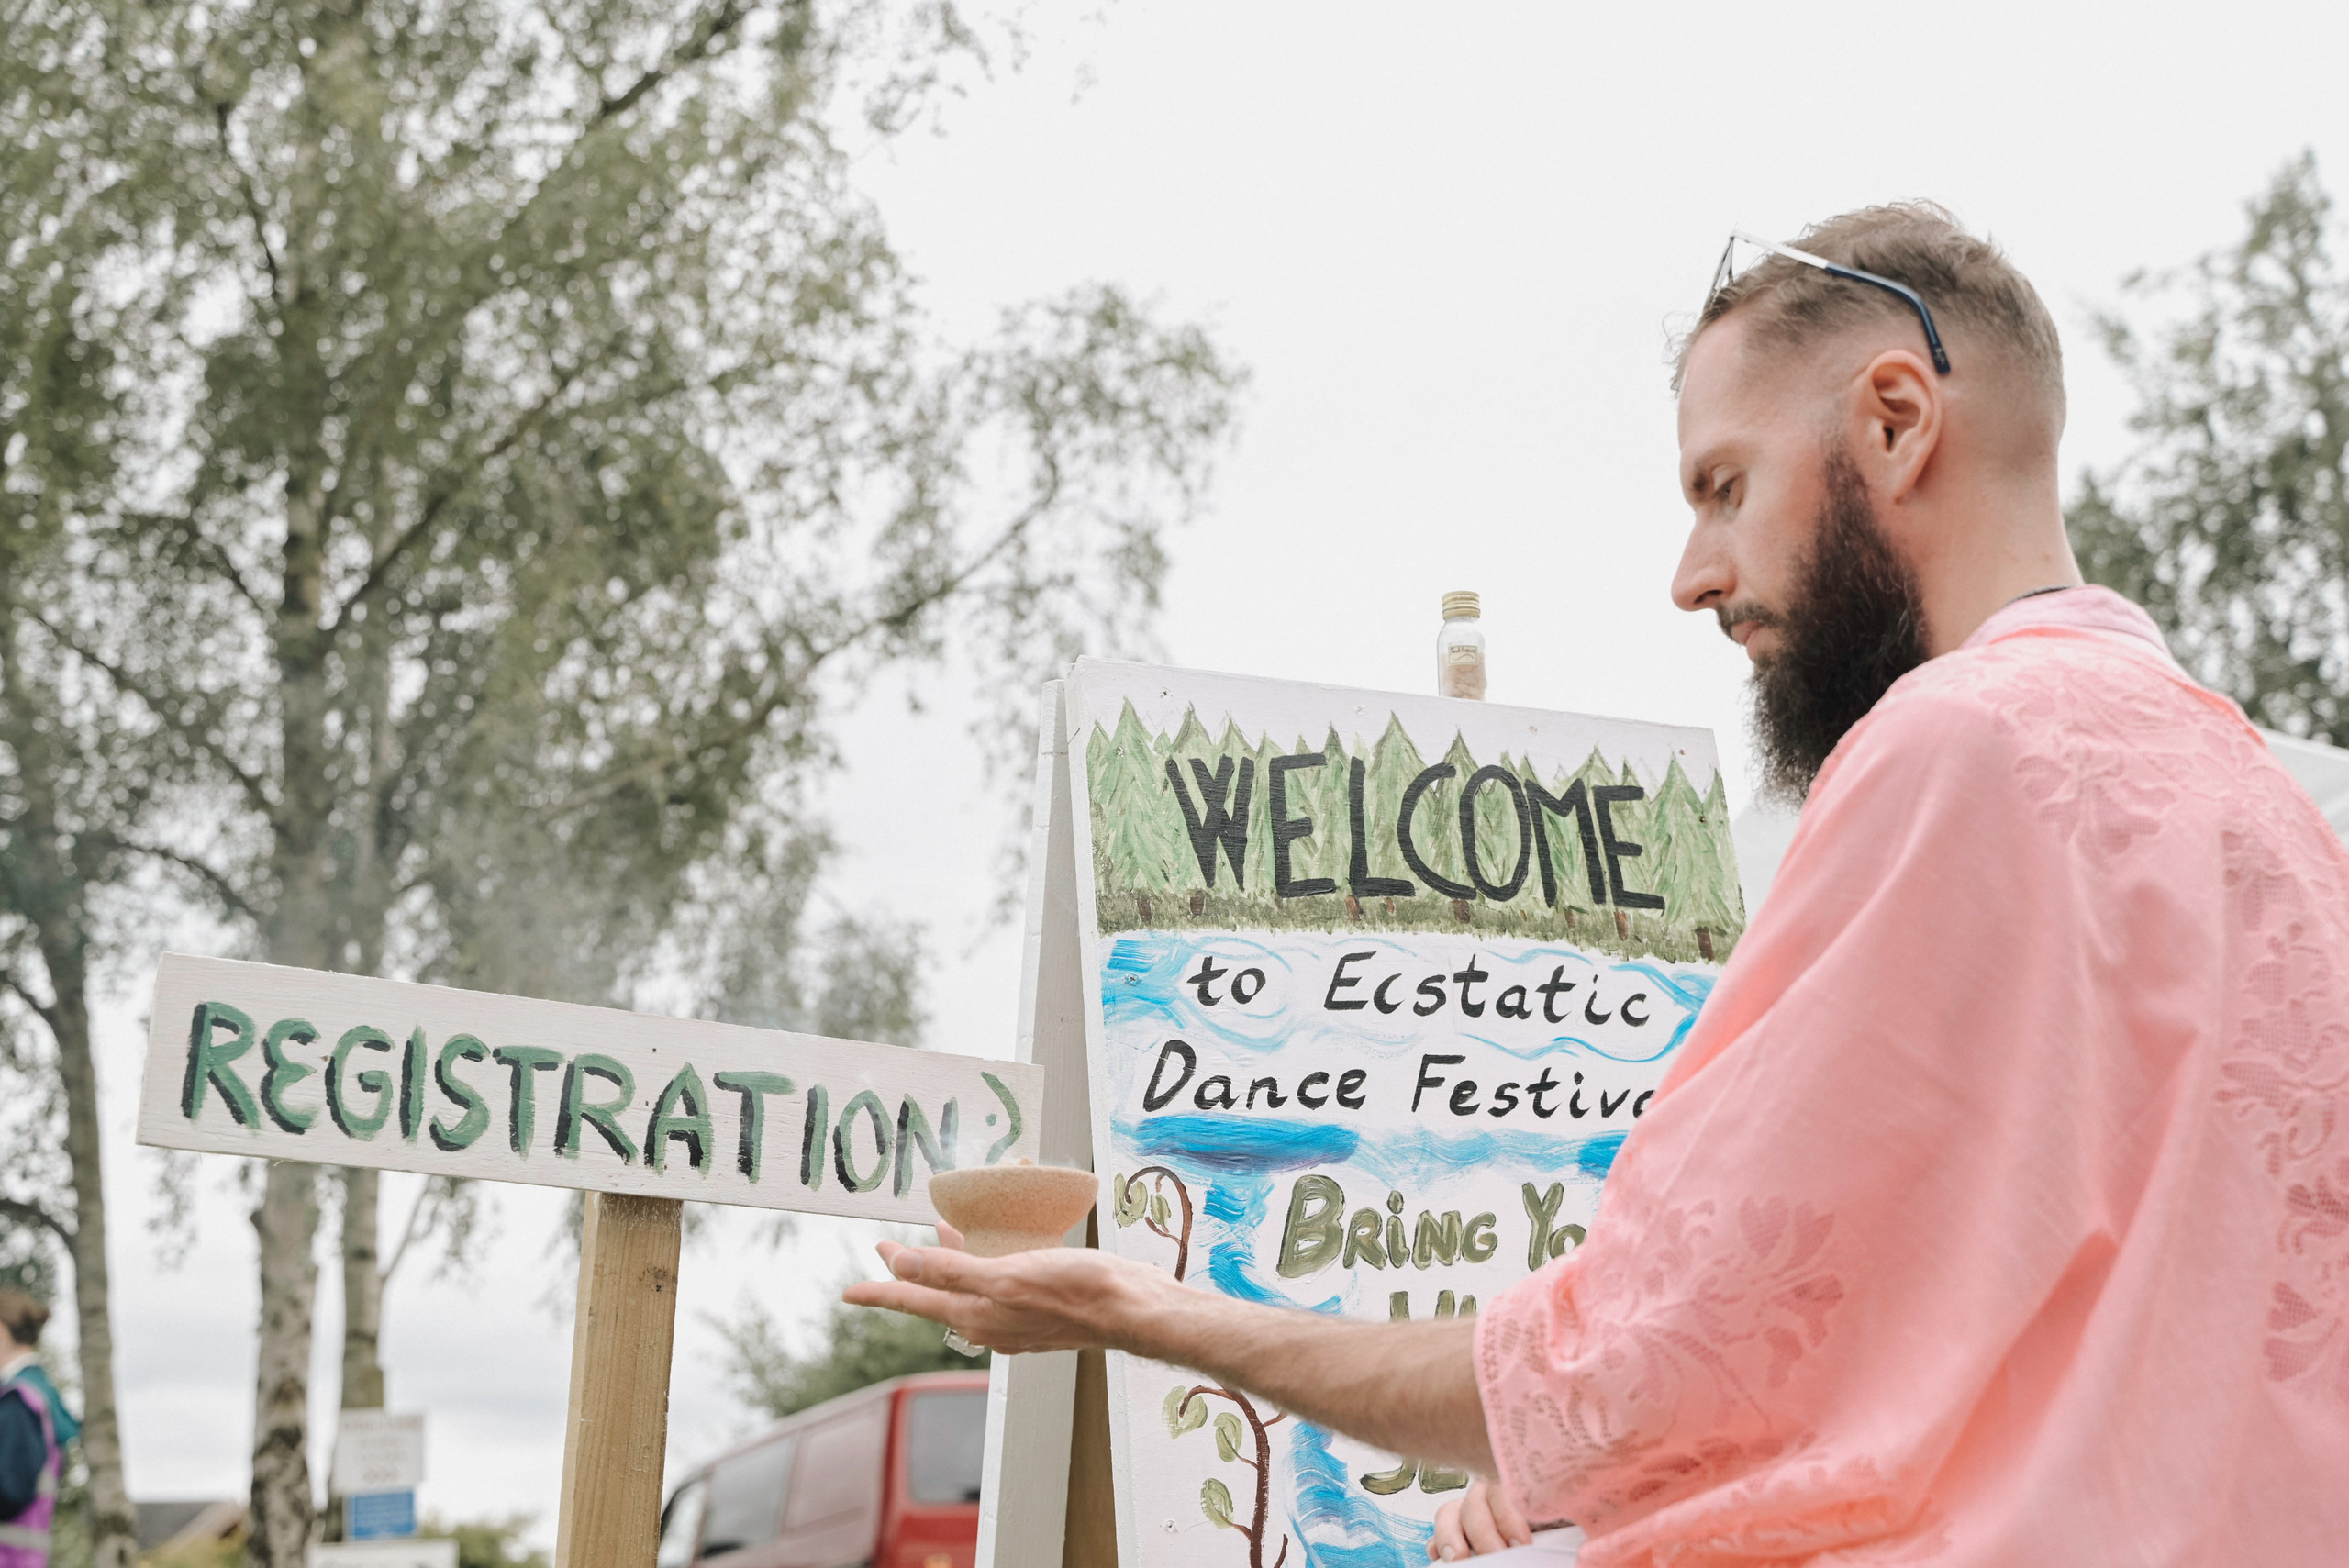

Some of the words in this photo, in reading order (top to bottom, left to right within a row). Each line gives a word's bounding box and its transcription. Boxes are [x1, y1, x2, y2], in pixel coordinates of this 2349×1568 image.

[1165, 754, 1665, 912] WELCOME
[1186, 955, 1266, 1006] to
[1323, 951, 1650, 1027] Ecstatic
[1142, 1040, 1368, 1112] Dance
